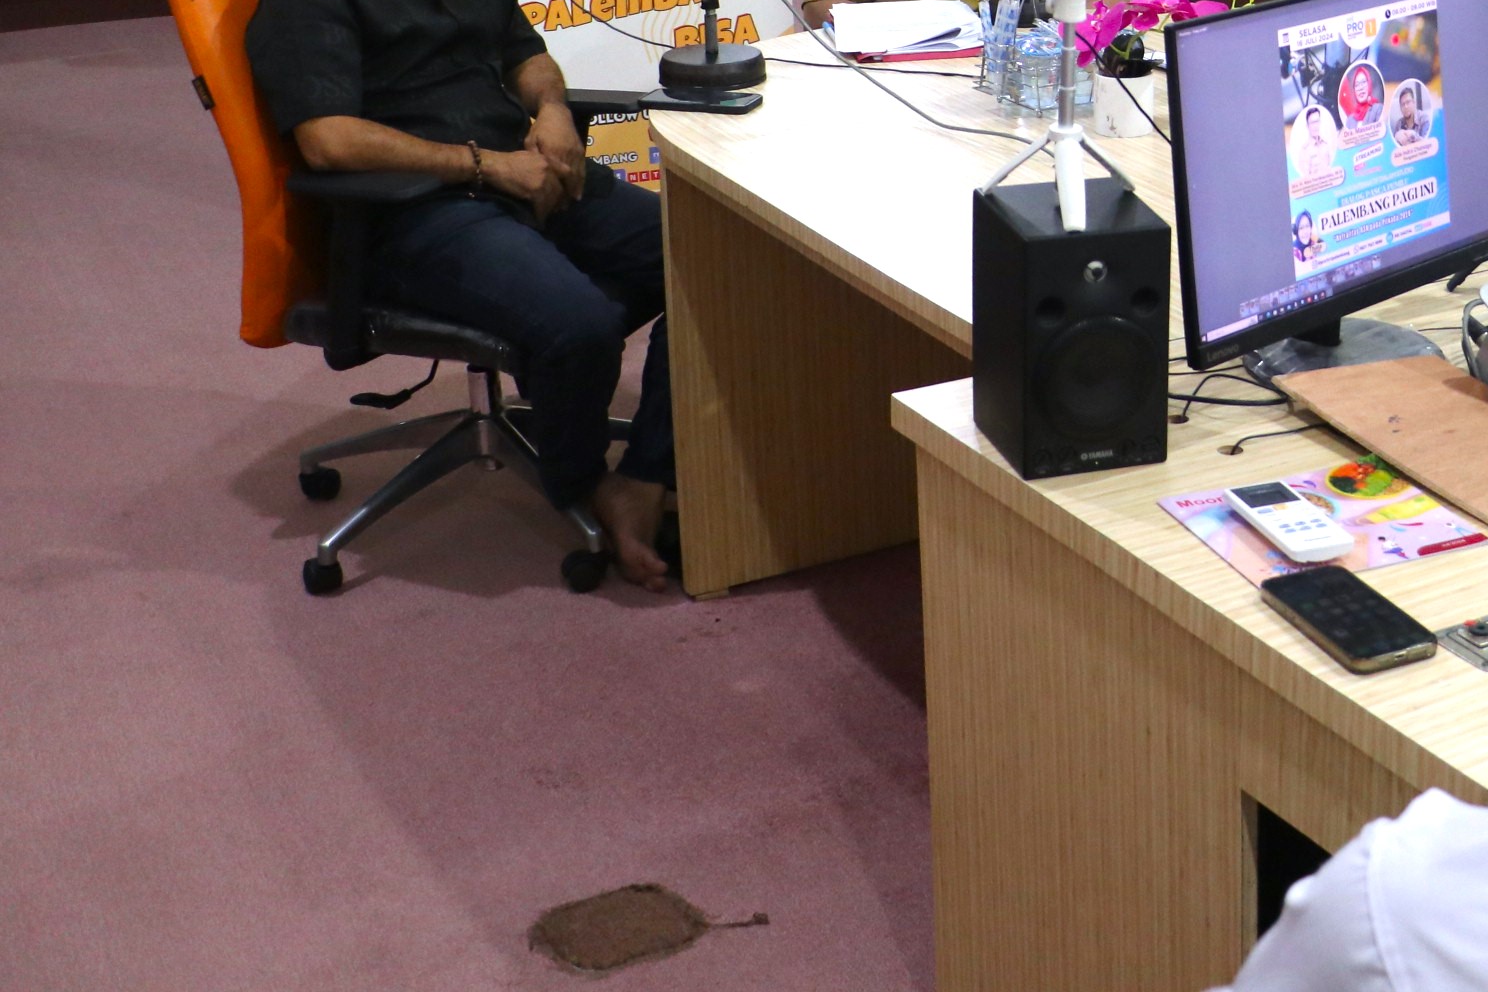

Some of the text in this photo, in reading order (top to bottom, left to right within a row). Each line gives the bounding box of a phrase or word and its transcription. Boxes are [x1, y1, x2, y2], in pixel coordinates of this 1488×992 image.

[1299, 25, 1327, 37] SELASA
[1346, 20, 1363, 33] PRO
[1304, 35, 1318, 46] JULI
[1318, 33, 1334, 43] 2024
[1320, 181, 1435, 230] PALEMBANG PAGI INI
